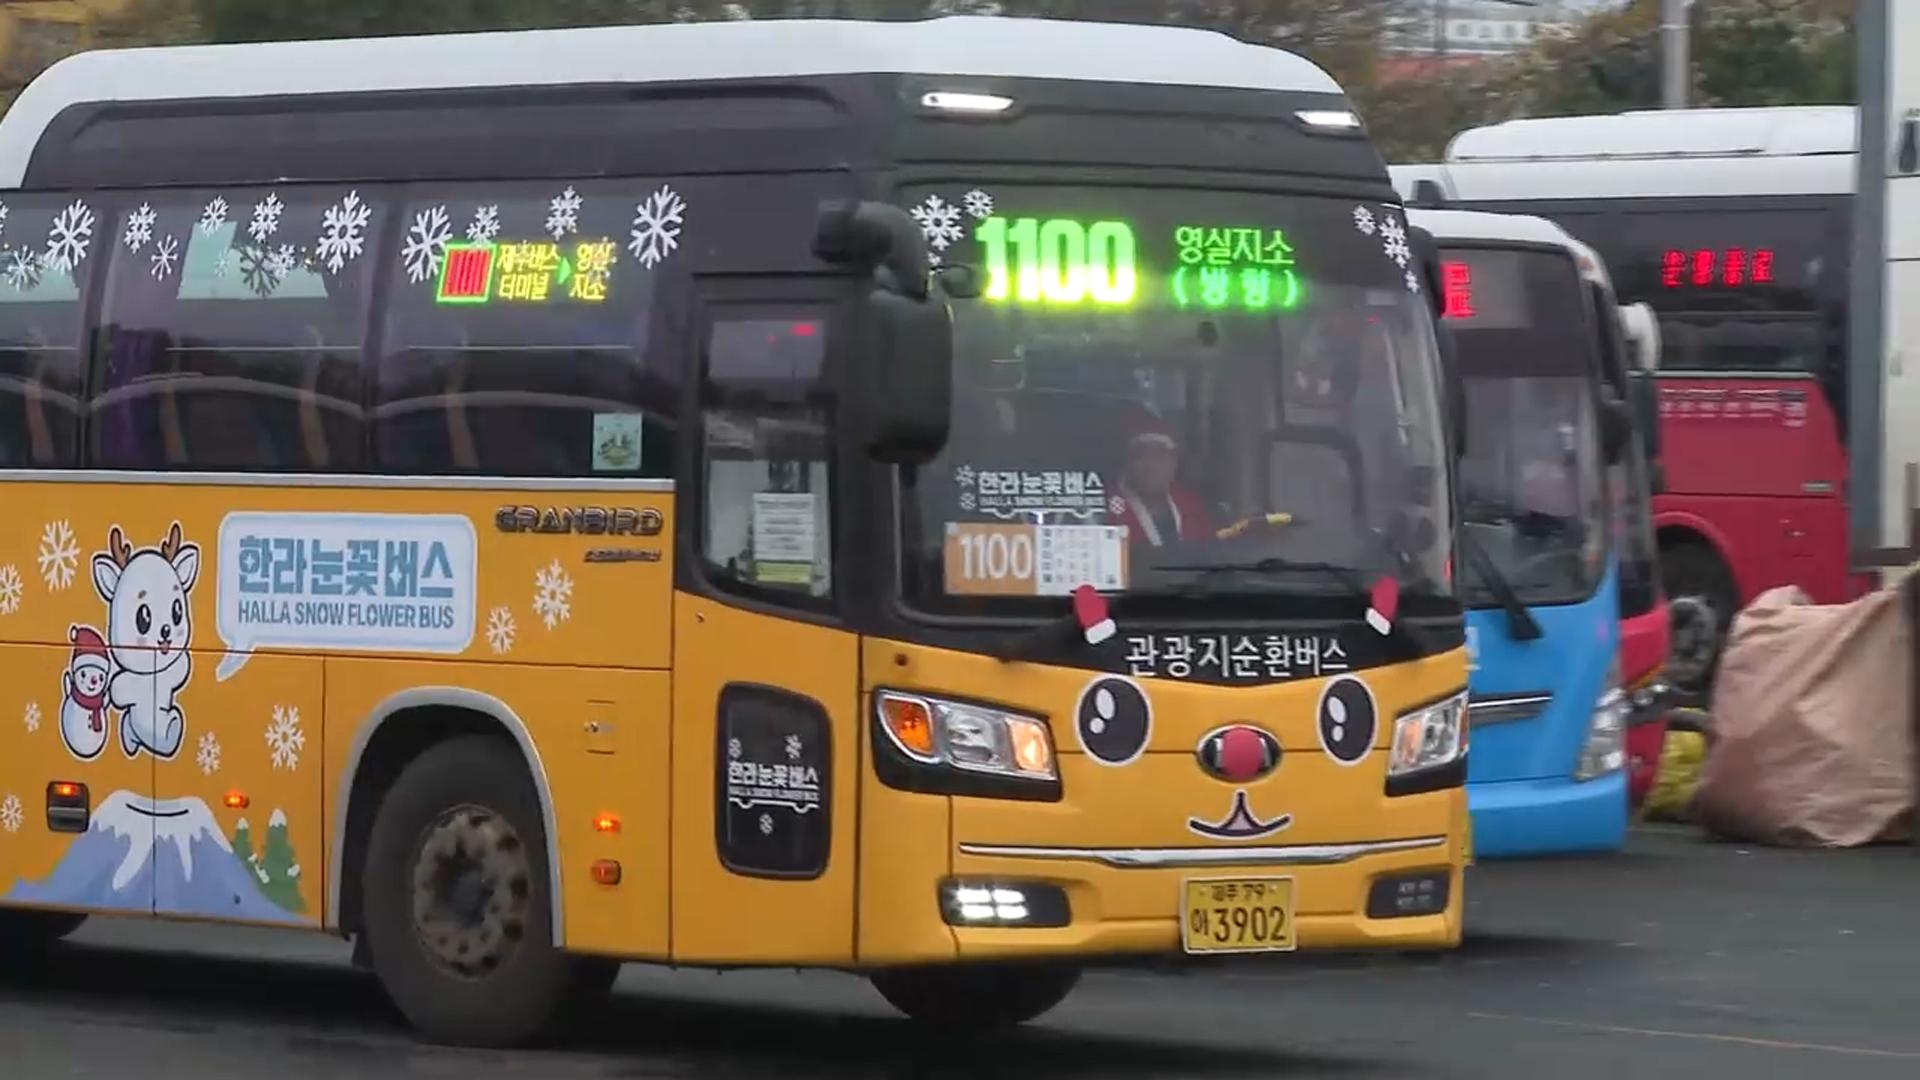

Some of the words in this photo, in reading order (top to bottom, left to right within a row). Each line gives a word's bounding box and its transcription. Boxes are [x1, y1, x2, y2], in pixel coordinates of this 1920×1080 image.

[496, 243, 562, 272] 제주버스
[976, 217, 1136, 302] 1100
[1176, 226, 1294, 265] 영실지소
[499, 273, 549, 301] 터미널
[568, 273, 607, 300] 지소
[496, 505, 663, 535] GRANBIRD
[960, 533, 1033, 580] 1100
[238, 601, 291, 624] HALLA
[294, 602, 344, 625] SNOW
[349, 603, 416, 628] FLOWER
[418, 605, 454, 629] BUS
[1125, 634, 1349, 678] 관광지순환버스
[1243, 883, 1265, 900] 79
